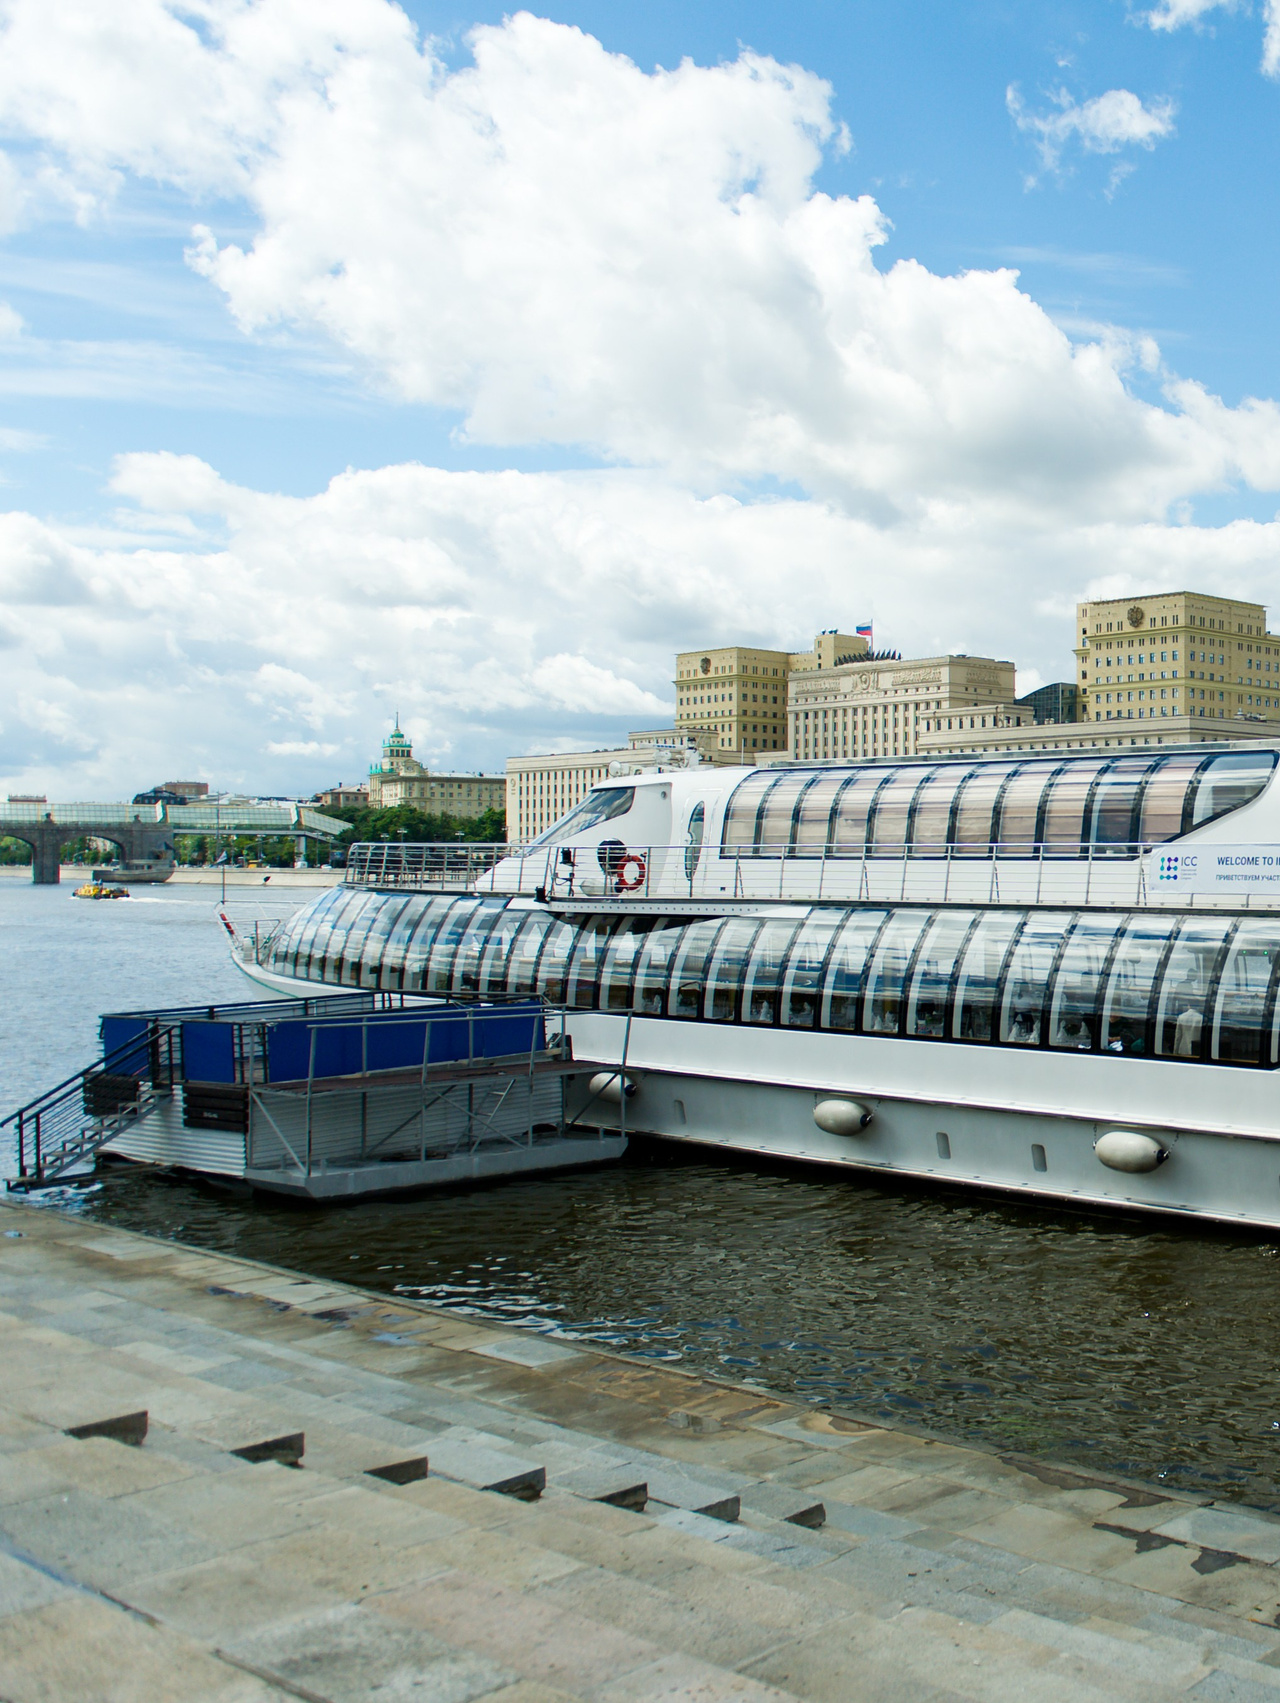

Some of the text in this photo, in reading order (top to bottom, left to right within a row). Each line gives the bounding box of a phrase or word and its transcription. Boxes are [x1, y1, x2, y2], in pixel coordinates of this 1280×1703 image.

[1181, 855, 1198, 867] ICC
[1217, 856, 1260, 866] WELCOME
[1261, 856, 1273, 866] TO
